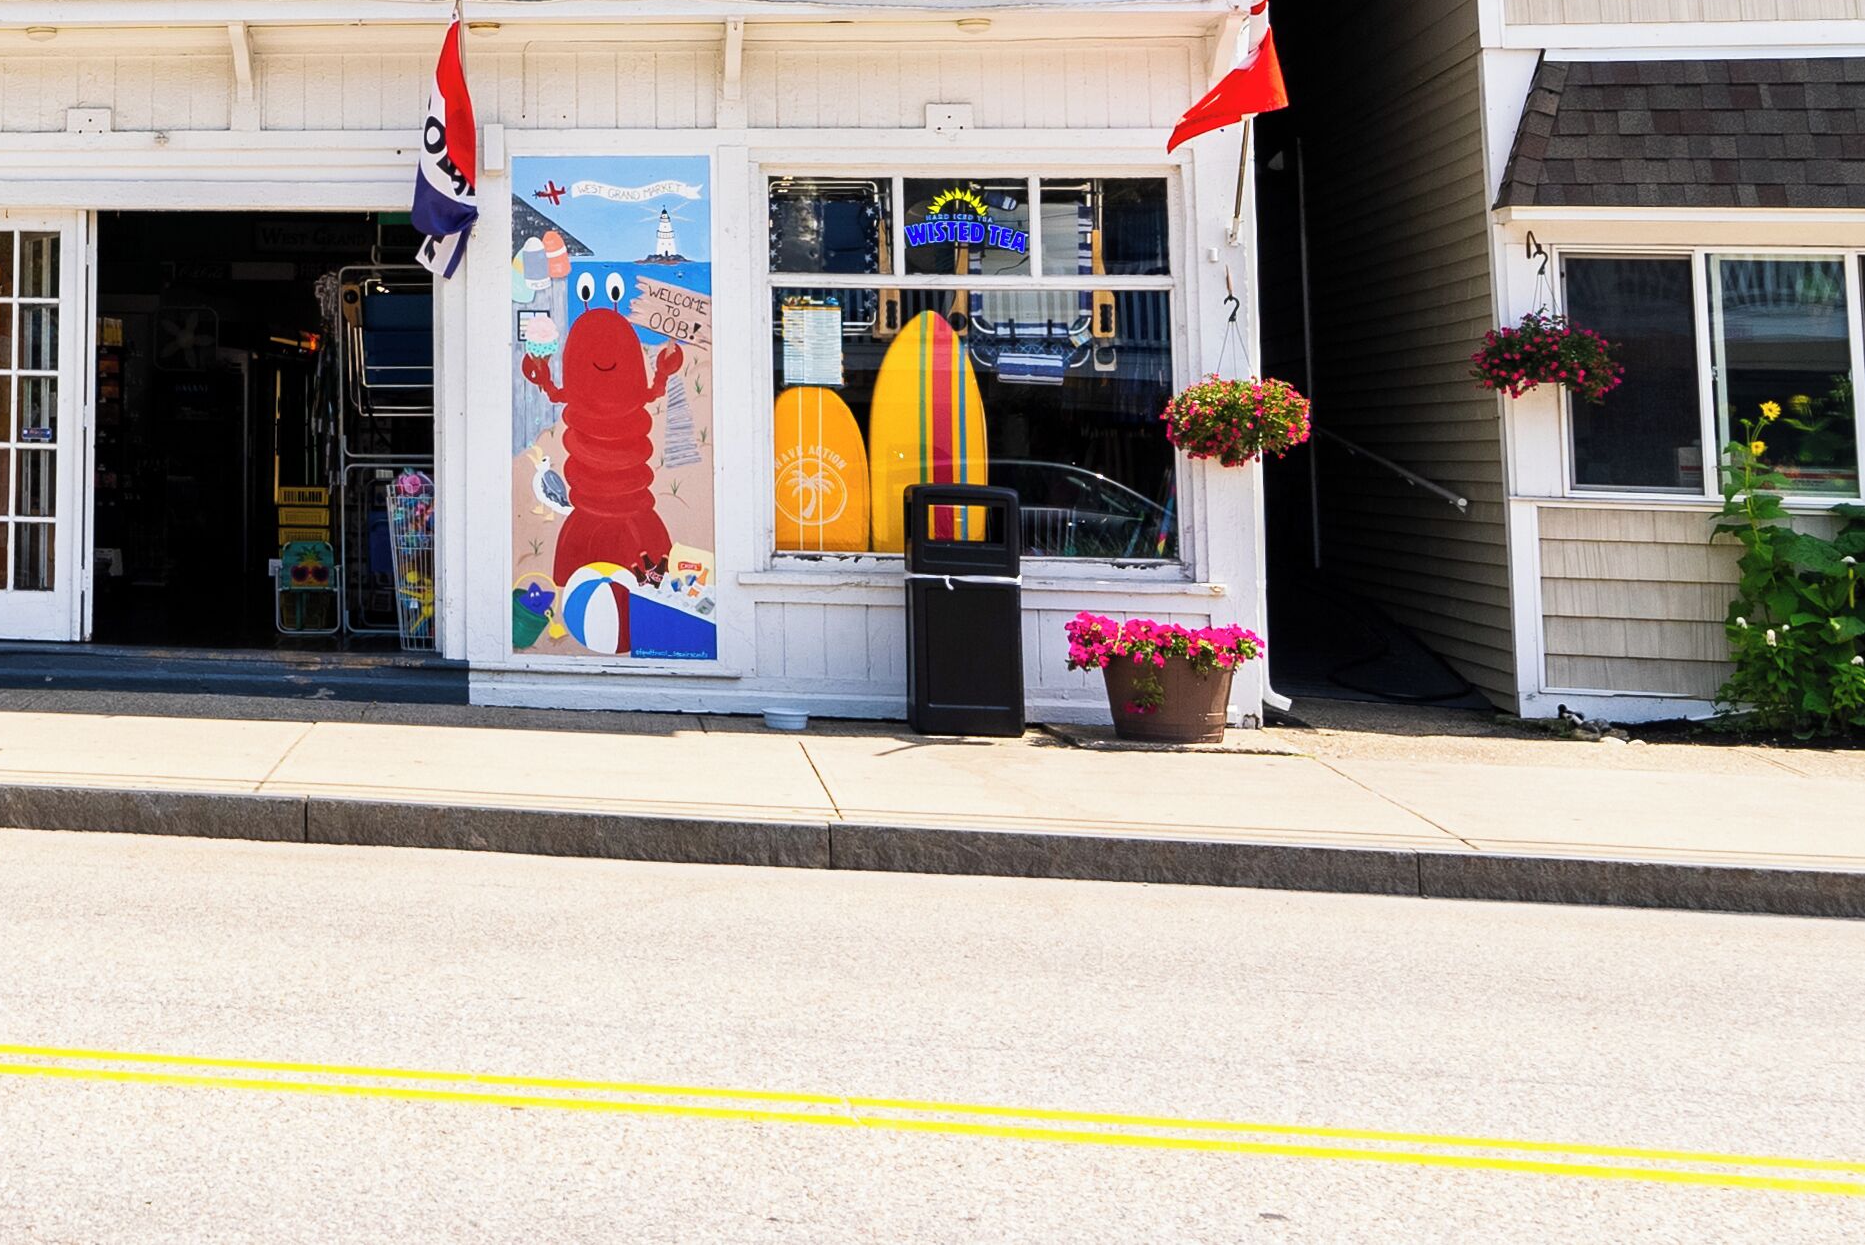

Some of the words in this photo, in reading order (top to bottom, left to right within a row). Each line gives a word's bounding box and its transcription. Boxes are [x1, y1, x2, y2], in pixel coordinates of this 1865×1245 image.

[577, 184, 603, 194] WEST
[608, 188, 640, 200] GRAND
[643, 183, 682, 196] MARKET
[978, 215, 994, 223] TEA
[904, 221, 985, 247] WISTED
[988, 224, 1028, 254] TEA
[648, 285, 709, 316] WELCOME
[665, 304, 680, 317] TO
[649, 312, 702, 340] OOB!
[808, 444, 848, 470] ACTION
